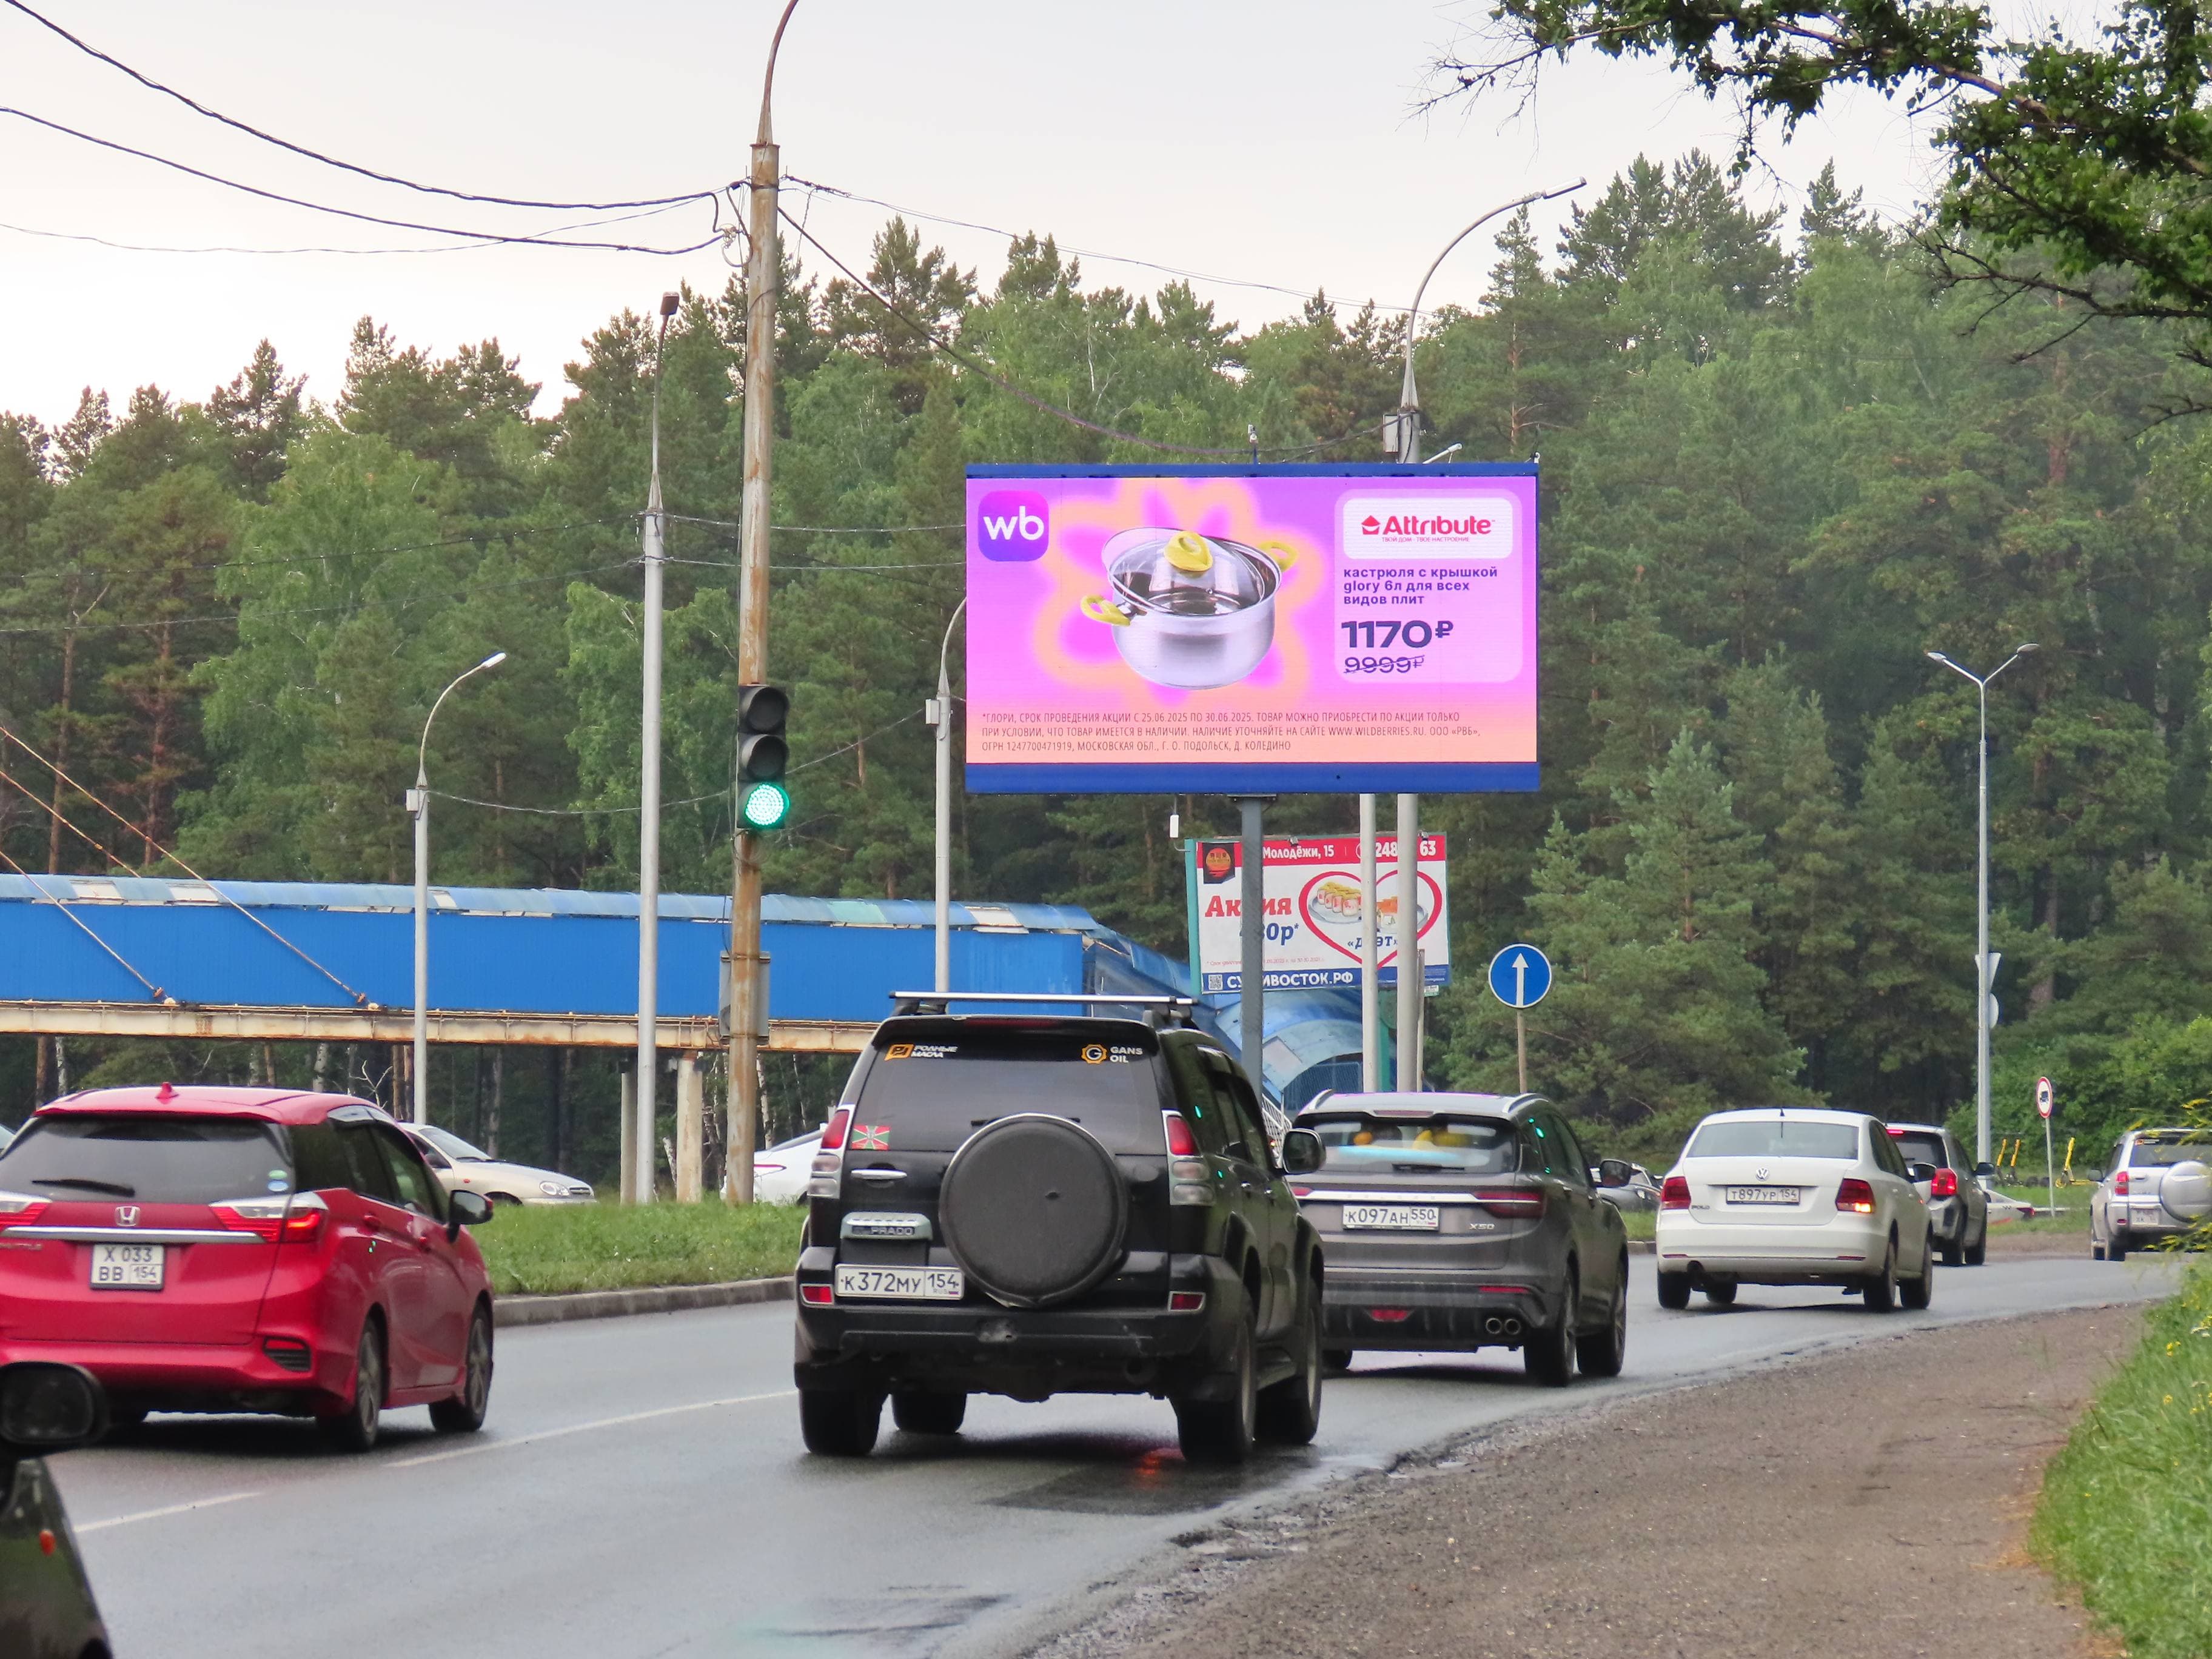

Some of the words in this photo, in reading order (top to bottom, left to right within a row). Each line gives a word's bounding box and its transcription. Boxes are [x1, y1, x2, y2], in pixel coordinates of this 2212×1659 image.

[983, 505, 1045, 540] wb
[1382, 515, 1492, 535] Attribute
[1344, 568, 1414, 580] кастрюля
[1431, 566, 1498, 580] крышкой
[1344, 581, 1379, 593] glory
[1384, 580, 1401, 591] 6л
[1406, 582, 1432, 592] для
[1437, 582, 1470, 591] всех
[1344, 596, 1387, 606] видов
[1019, 712, 1041, 723] СРОК
[1044, 712, 1099, 723] ПРОВЕДЕНИЯ
[1102, 712, 1131, 723] АКЦИИ
[1134, 712, 1139, 722] С
[1142, 712, 1187, 722] 25.06.2025
[1190, 712, 1202, 722] ПО
[1205, 712, 1254, 722] 30.06.2025.
[1257, 712, 1283, 722] ТОВАР
[1285, 712, 1319, 722] МОЖНО
[1322, 712, 1377, 722] ПРИОБРЕСТИ
[1380, 712, 1392, 722] ПО
[1395, 712, 1424, 723] АКЦИИ
[1427, 712, 1460, 722] ТОЛЬКО
[982, 727, 999, 736] ПРИ
[1002, 727, 1044, 738] УСЛОВИИ,
[1047, 727, 1063, 736] ЧТО
[1067, 727, 1093, 736] ТОВАР
[1096, 727, 1134, 736] ИМЕЕТСЯ
[1138, 727, 1142, 736] В
[1145, 727, 1189, 736] НАЛИЧИИ.
[1193, 727, 1232, 736] НАЛИЧИЕ
[1235, 725, 1283, 736] УТОЧНЯЙТЕ
[1286, 727, 1297, 736] НА
[1300, 725, 1325, 736] САЙТЕ
[982, 741, 1004, 751] ОГРН
[1007, 741, 1074, 752] 1247700471919,
[1078, 741, 1134, 751] МОСКОВСКАЯ
[1137, 741, 1159, 751] ОБЛ.,
[1184, 741, 1231, 751] ПОДОЛЬСК,
[1245, 741, 1291, 751] КОЛЕДИНО
[1263, 845, 1321, 859] Молодёжи,
[1323, 845, 1335, 857] 15
[1205, 896, 1292, 917] Акия
[1227, 971, 1353, 988] СУИВОСТОК.РФ
[1110, 1047, 1143, 1055] GANS
[1780, 1188, 1797, 1198] 154
[1411, 1208, 1434, 1220] 550
[122, 1247, 152, 1262] 033
[133, 1266, 156, 1278] 154
[927, 1273, 956, 1289] 154
